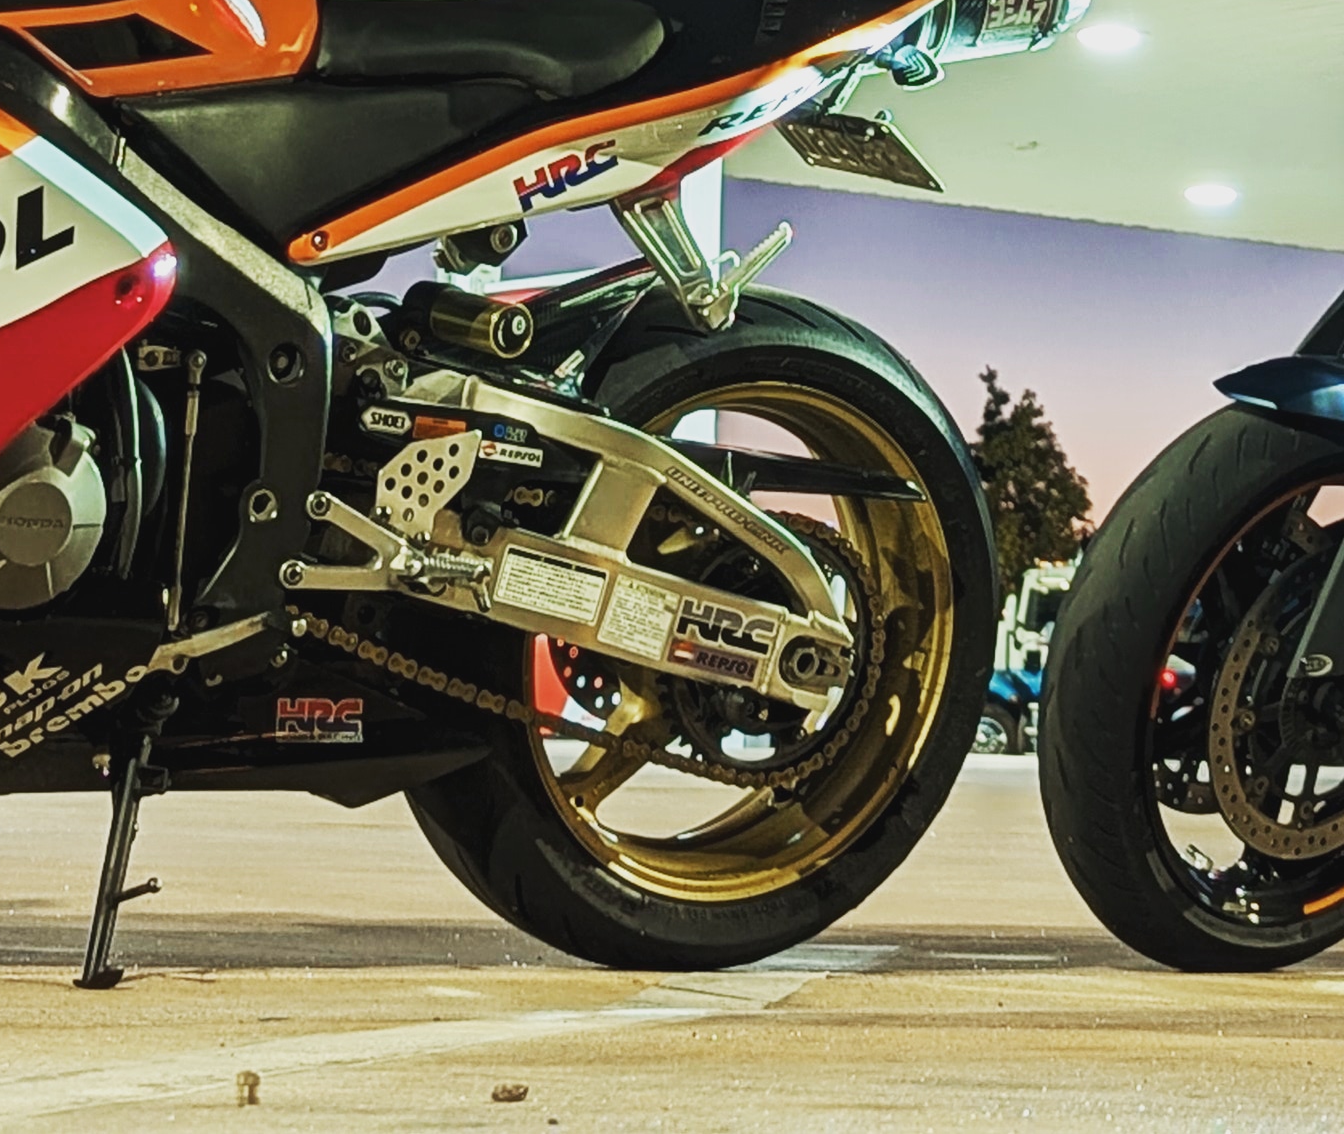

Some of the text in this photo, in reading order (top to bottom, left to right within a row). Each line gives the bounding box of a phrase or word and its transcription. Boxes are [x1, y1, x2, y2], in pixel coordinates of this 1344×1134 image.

[513, 139, 619, 211] HRC
[369, 411, 406, 430] SHOEI
[675, 598, 776, 655] HRC
[277, 698, 363, 735] HRC
